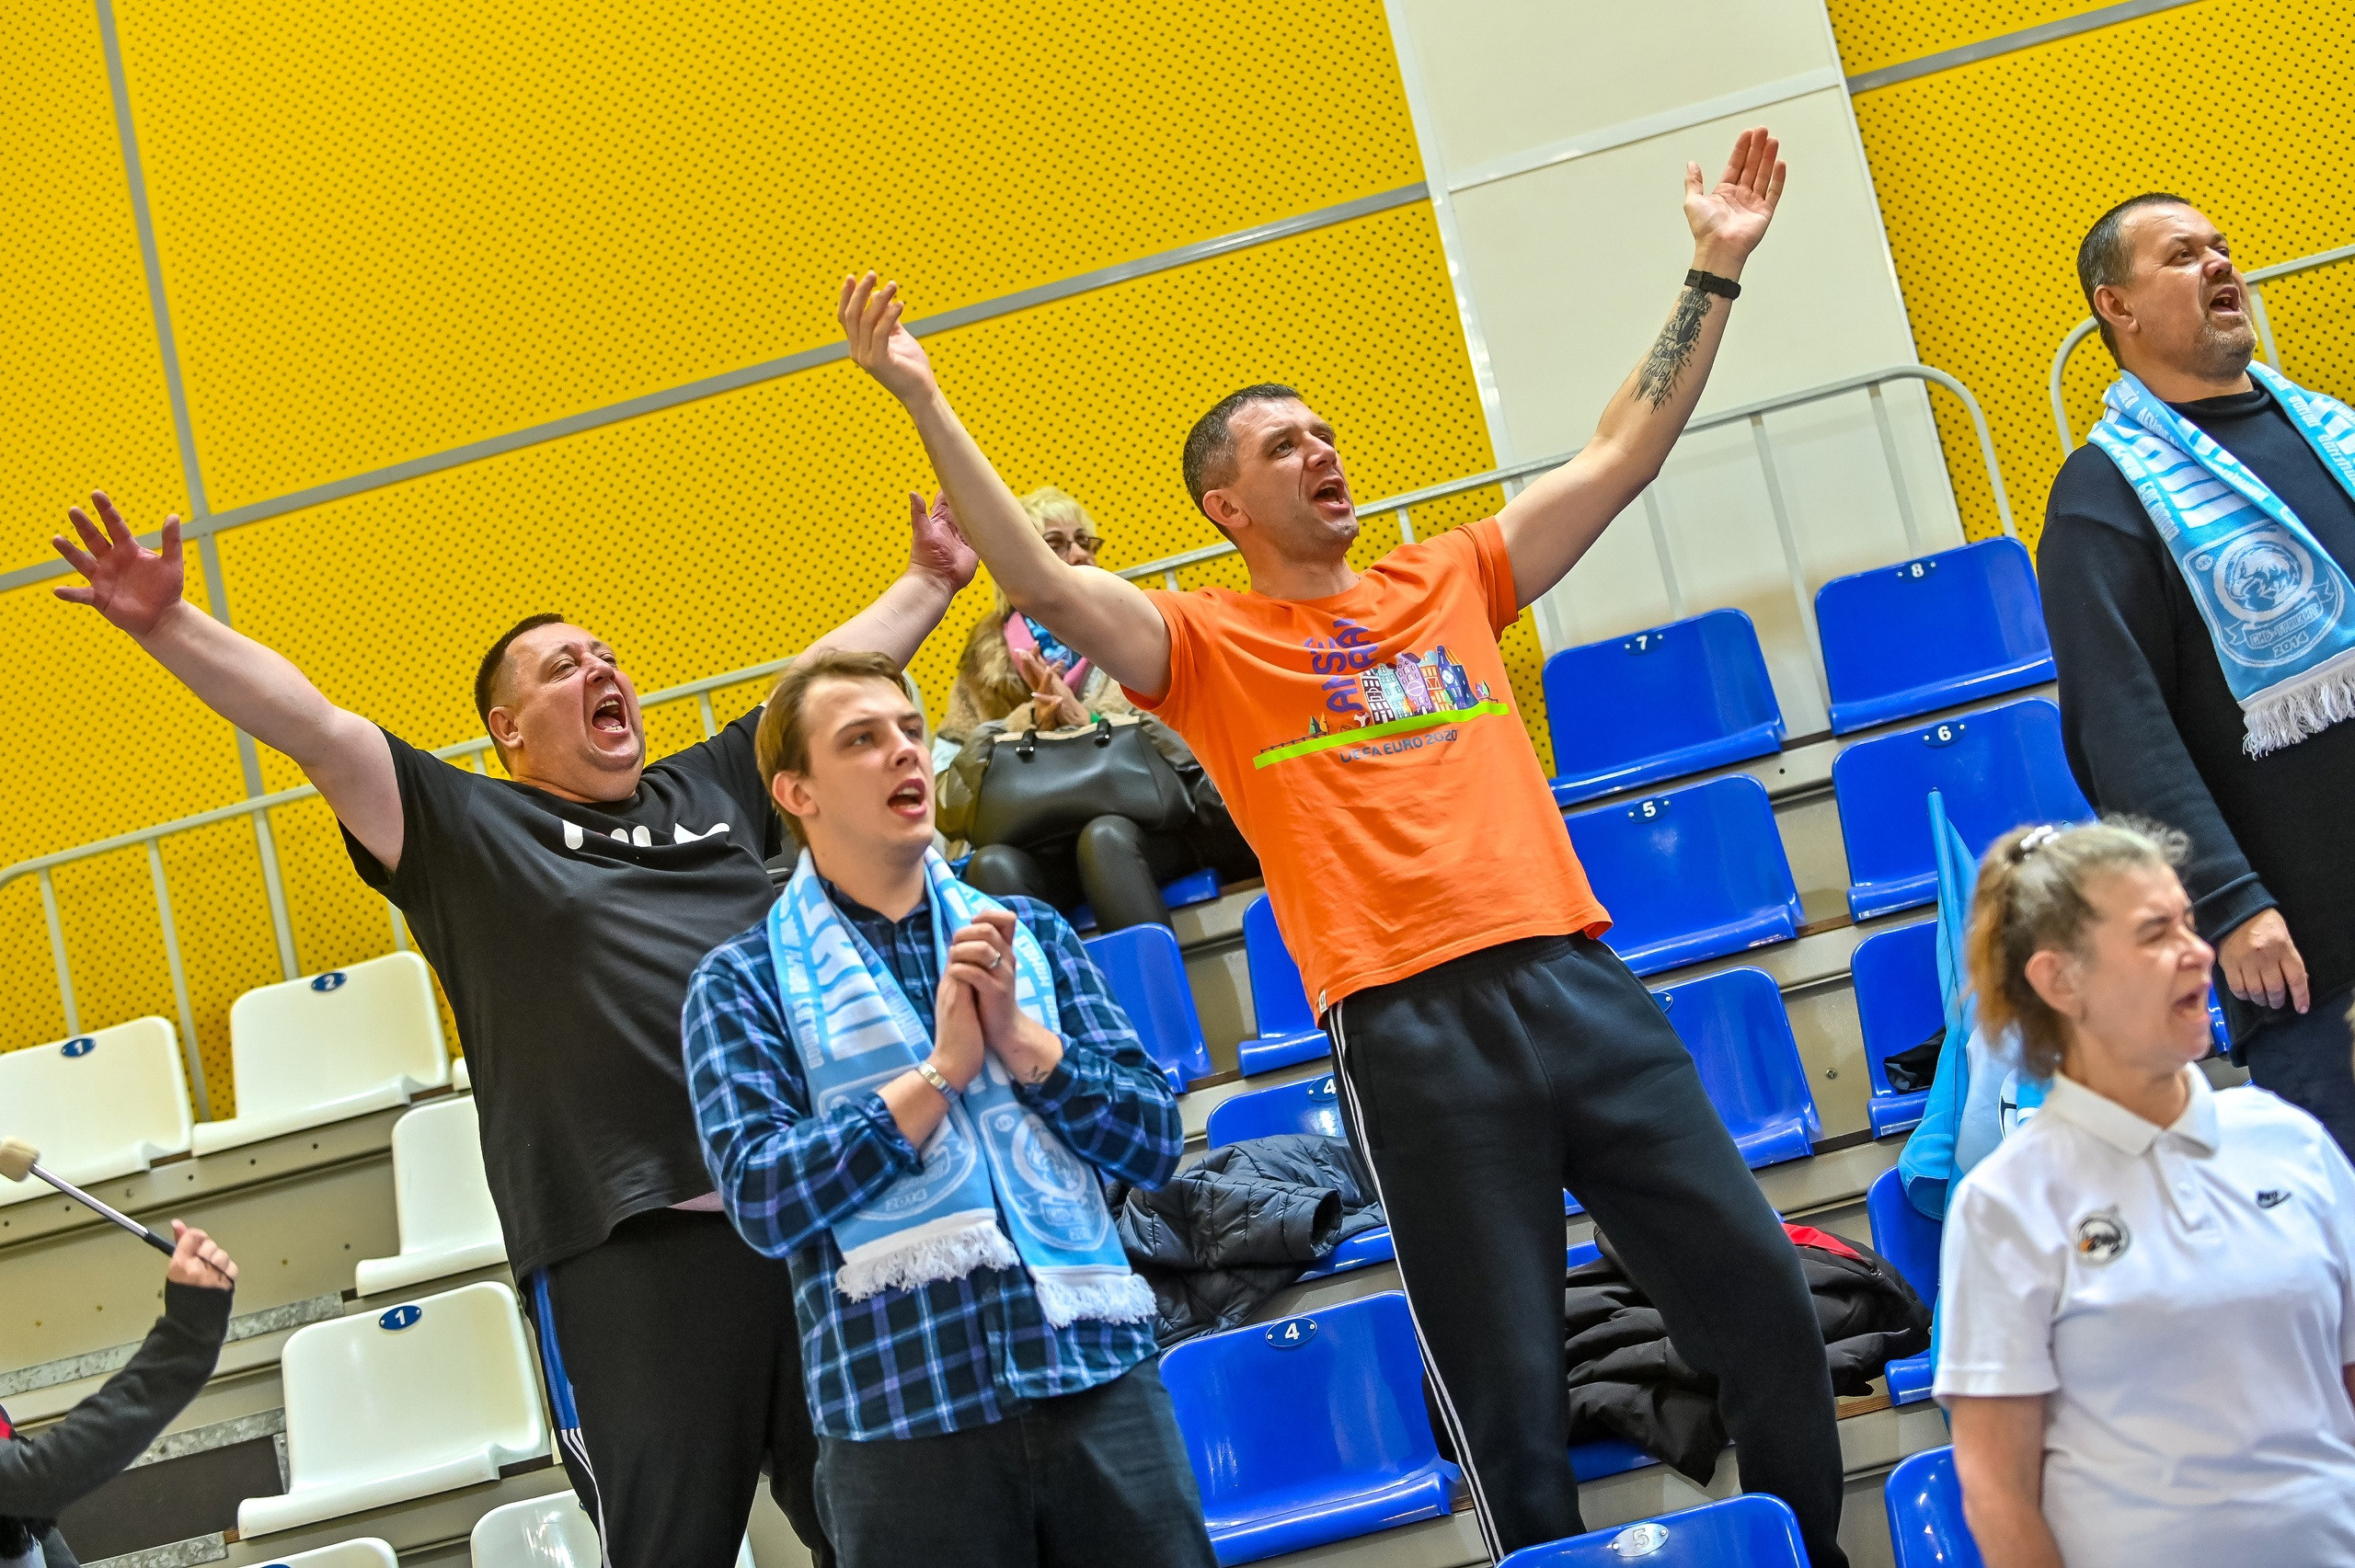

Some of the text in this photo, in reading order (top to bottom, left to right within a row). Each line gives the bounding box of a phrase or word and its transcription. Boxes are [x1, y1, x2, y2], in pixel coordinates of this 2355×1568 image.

[1911, 563, 1924, 578] 8
[1636, 635, 1648, 650] 7
[1937, 725, 1952, 741] 6
[1340, 729, 1458, 763] UEFA EURO 2020
[1642, 800, 1657, 818] 5
[324, 975, 337, 990] 2
[74, 1040, 84, 1055] 1
[1323, 1078, 1337, 1094] 4
[395, 1309, 406, 1326] 1
[1284, 1322, 1300, 1340] 4
[1632, 1528, 1649, 1549] 5
